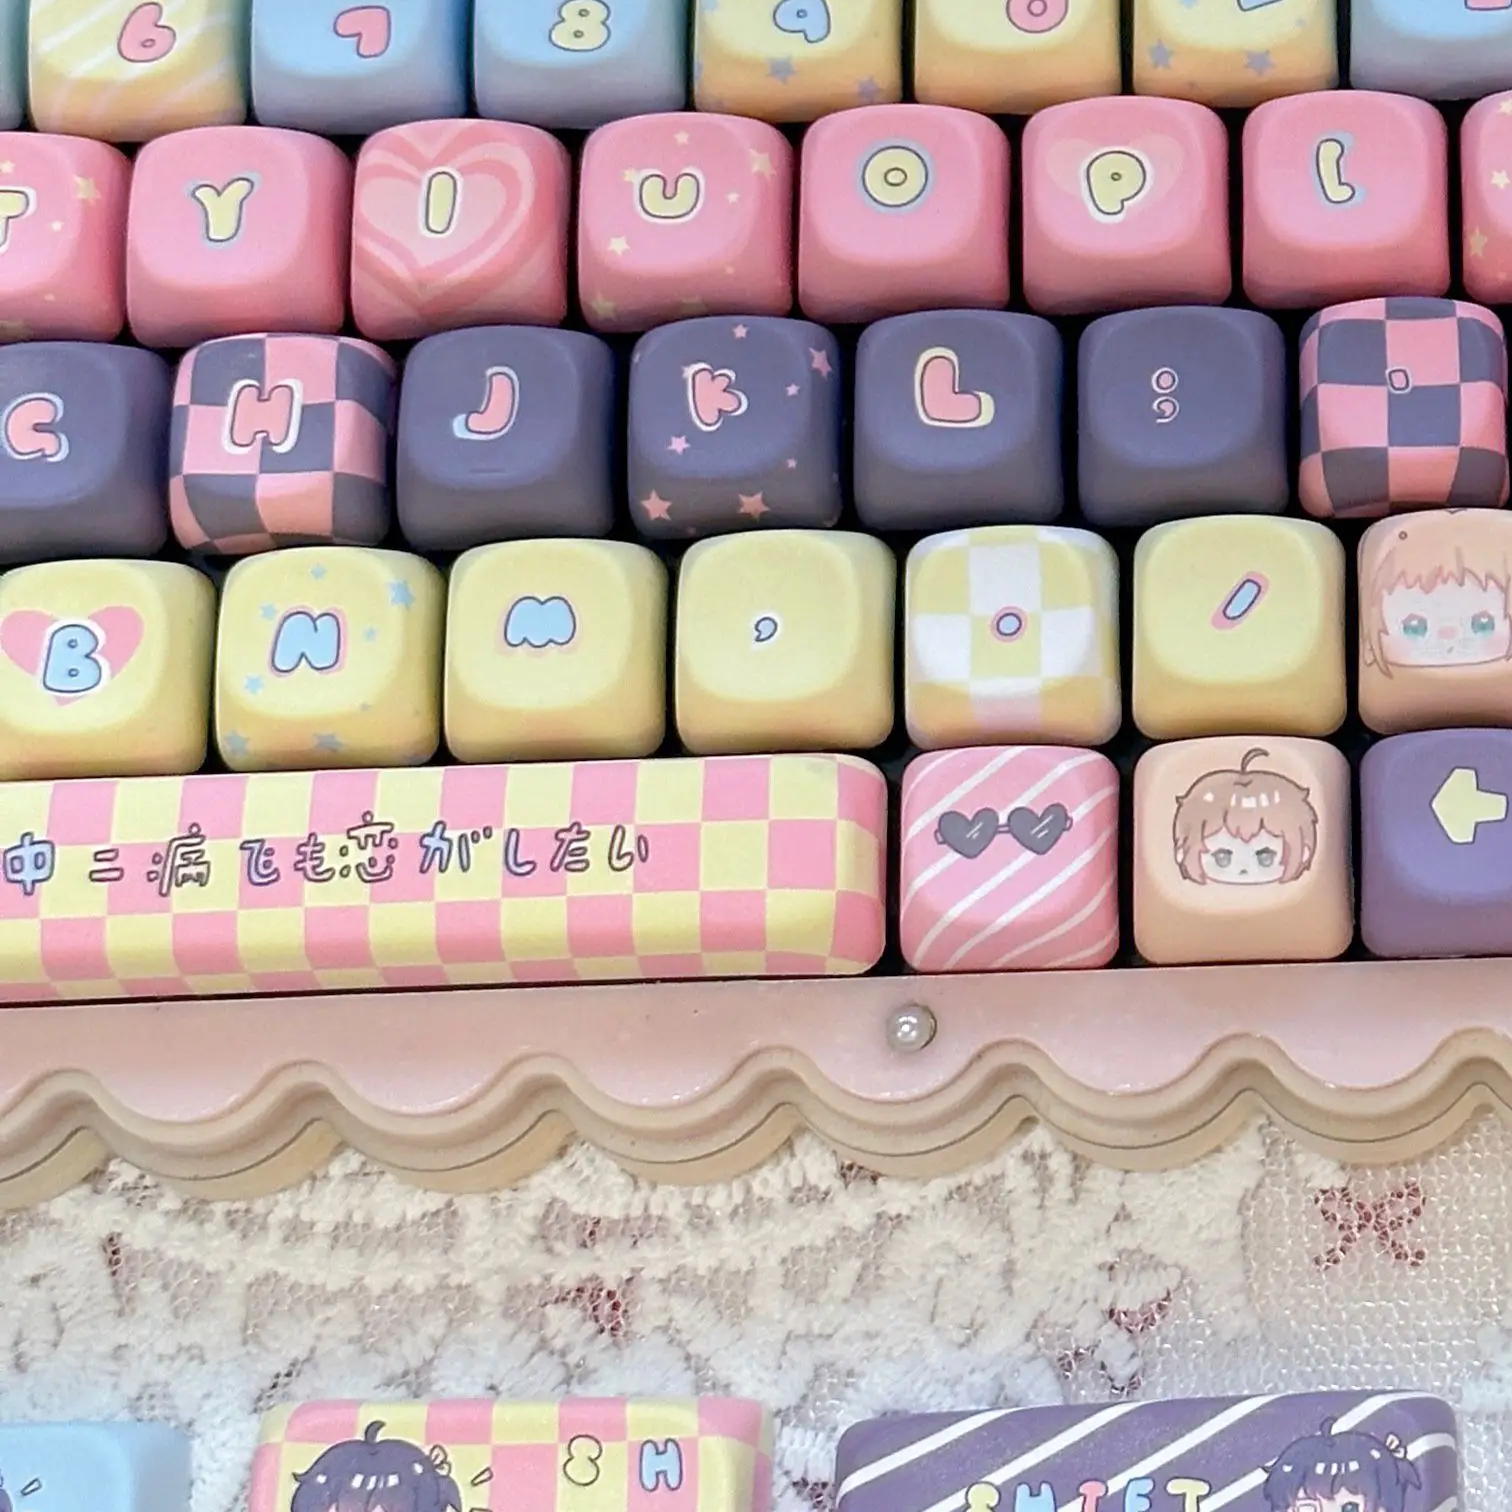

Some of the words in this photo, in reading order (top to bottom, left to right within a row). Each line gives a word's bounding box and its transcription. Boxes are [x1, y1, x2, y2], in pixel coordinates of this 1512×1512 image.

[118, 1, 177, 63] 6
[334, 5, 391, 58] 7
[420, 169, 461, 238] I
[637, 171, 701, 220] U
[861, 143, 930, 209] O
[1085, 149, 1148, 216] P
[191, 175, 258, 245] Y
[225, 380, 300, 451] H
[458, 368, 518, 438] J
[687, 363, 748, 430] K
[916, 350, 993, 426] L
[1151, 366, 1180, 424] ;
[270, 610, 343, 675] N
[501, 594, 578, 650] M
[42, 622, 104, 694] B
[2, 811, 650, 897] 中二病でも恋がしたい
